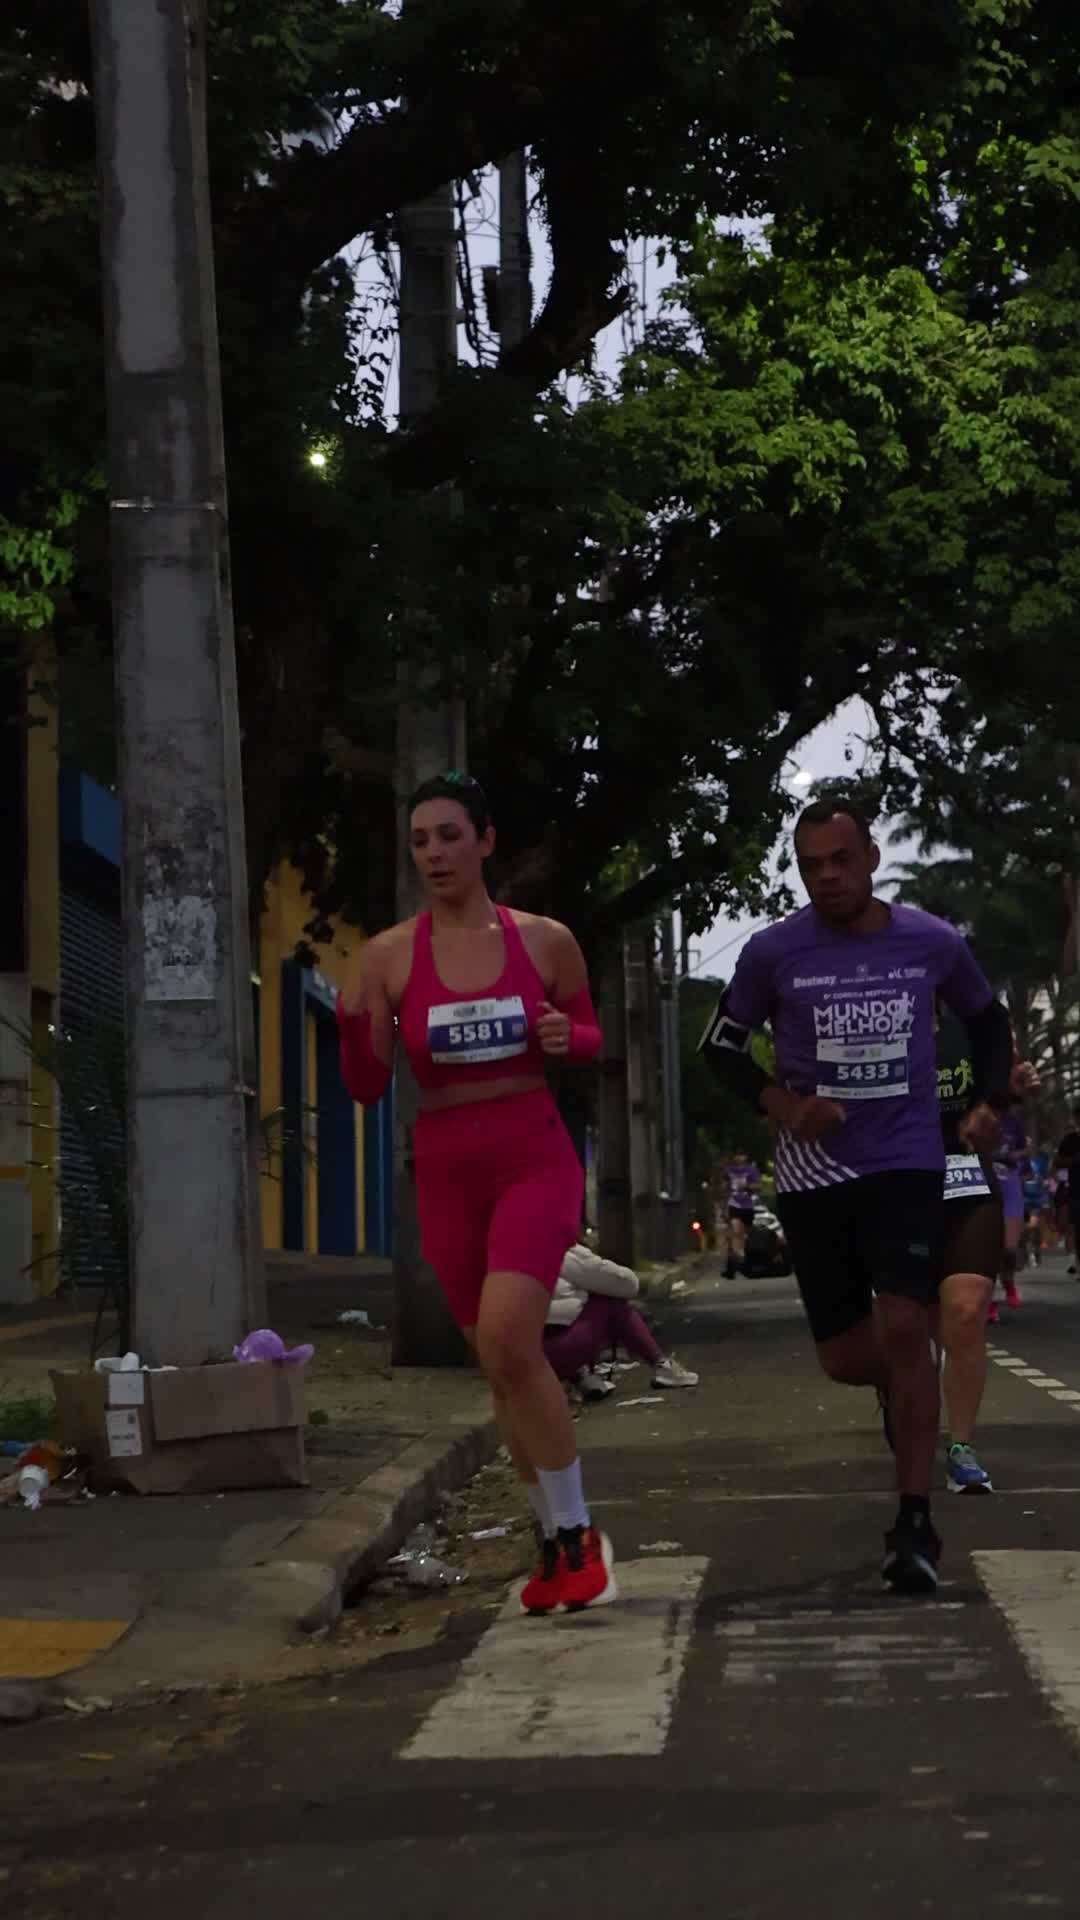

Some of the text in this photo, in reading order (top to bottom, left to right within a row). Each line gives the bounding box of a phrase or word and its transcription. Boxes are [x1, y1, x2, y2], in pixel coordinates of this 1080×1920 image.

[813, 1000, 903, 1020] MUNDO
[448, 1019, 504, 1045] 5581
[815, 1015, 905, 1037] MELHOR
[836, 1063, 889, 1080] 5433
